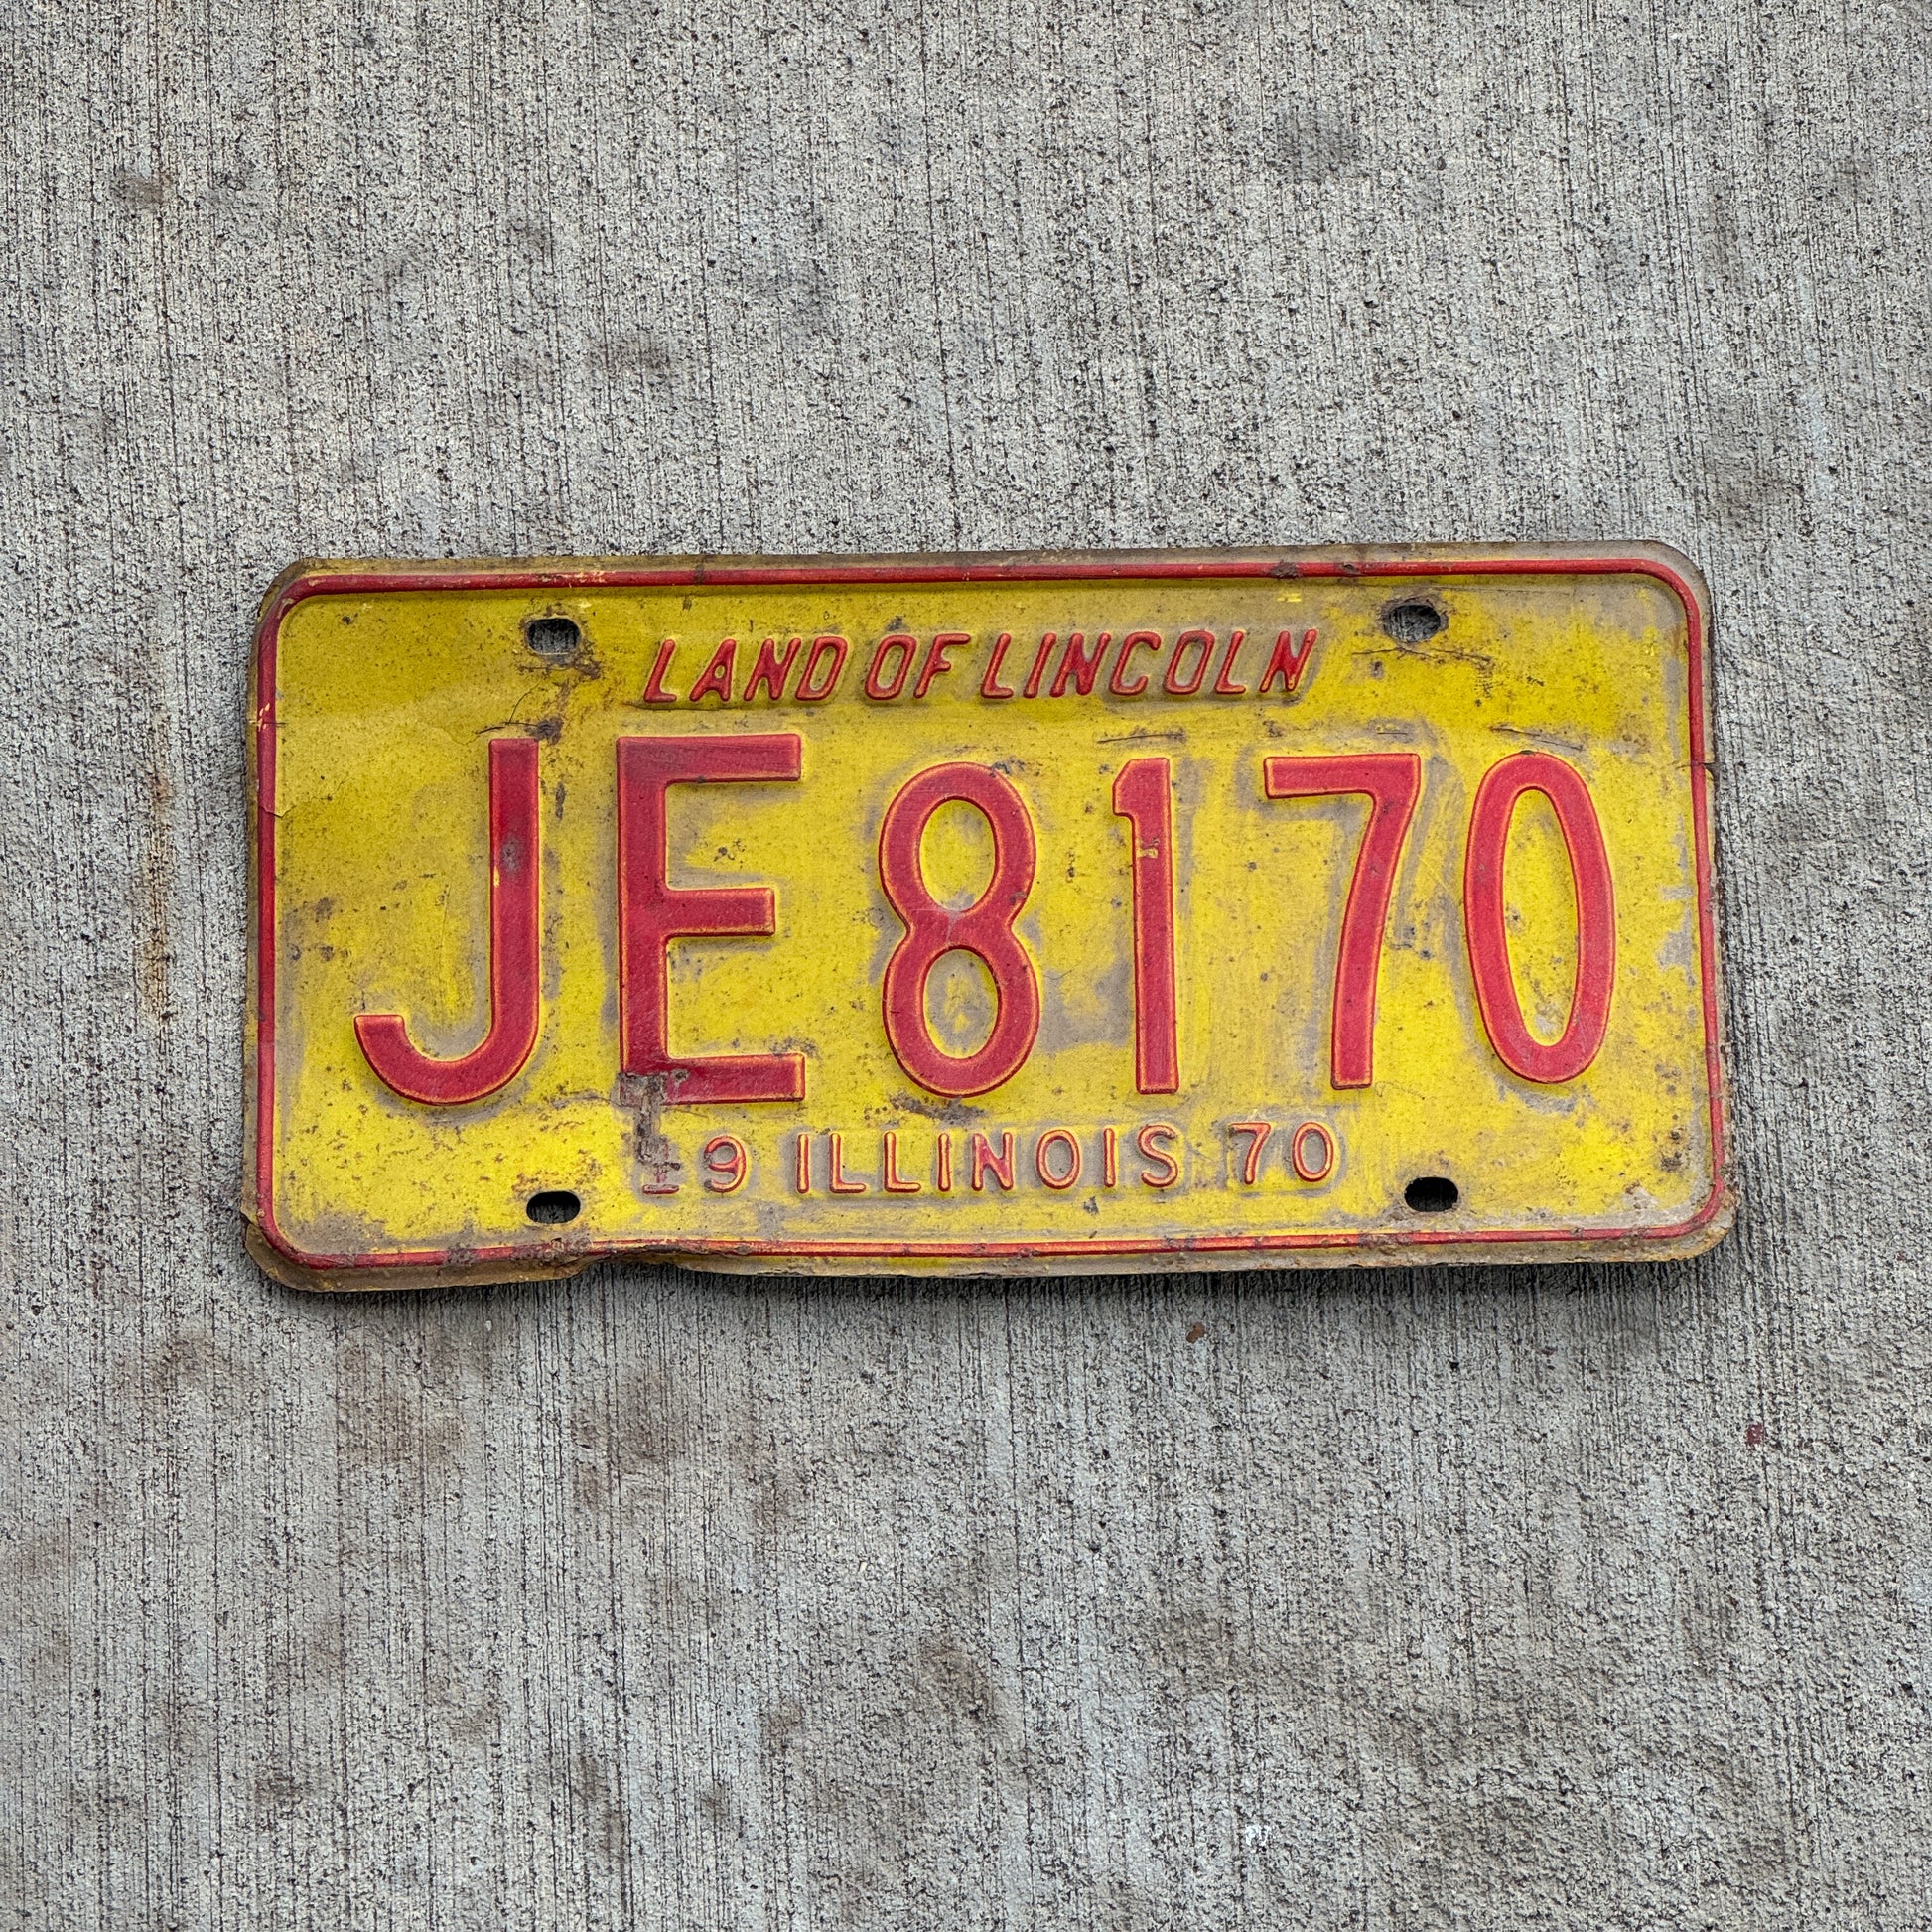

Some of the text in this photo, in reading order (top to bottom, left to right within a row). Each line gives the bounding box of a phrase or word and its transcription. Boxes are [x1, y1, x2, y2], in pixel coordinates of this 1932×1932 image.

[643, 628, 1318, 704] LAND OF LINCOLN
[796, 1123, 1179, 1194] ILLINOIS
[1230, 1121, 1333, 1185] 70
